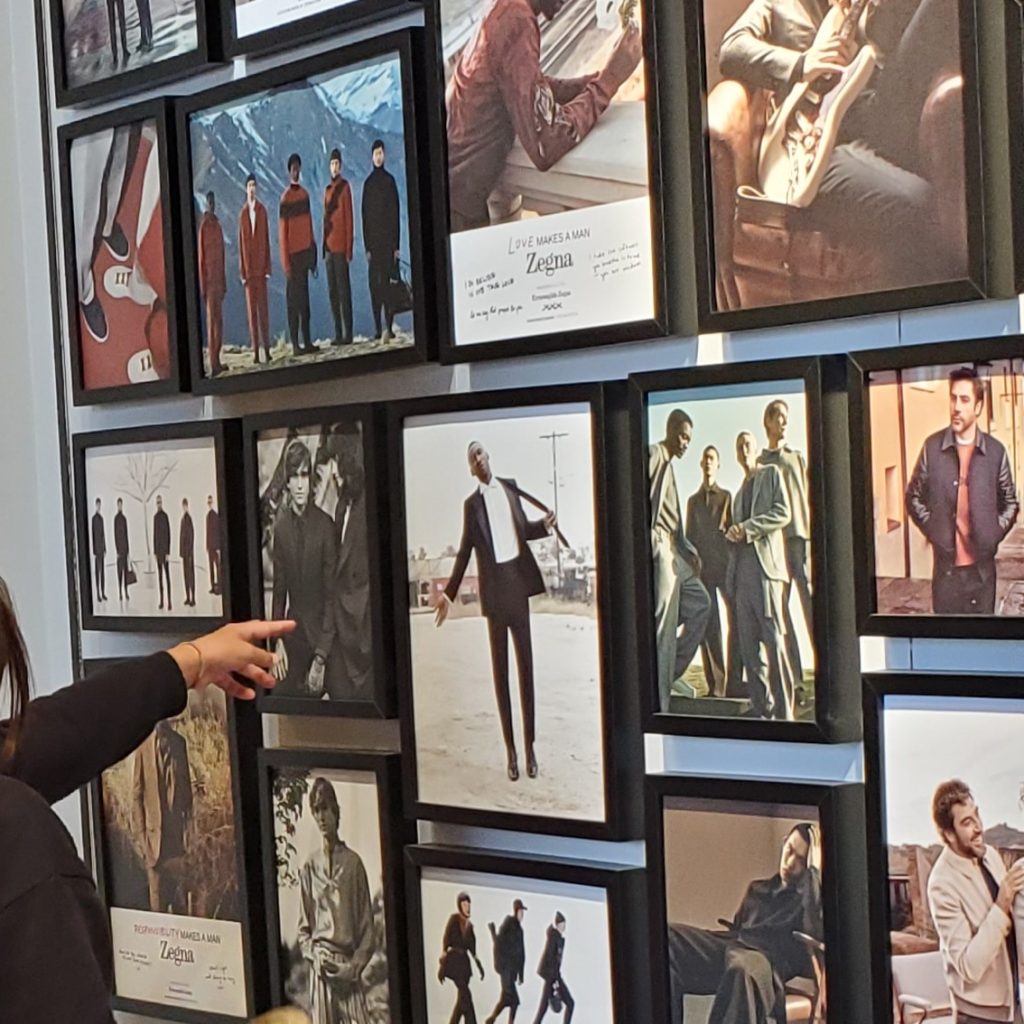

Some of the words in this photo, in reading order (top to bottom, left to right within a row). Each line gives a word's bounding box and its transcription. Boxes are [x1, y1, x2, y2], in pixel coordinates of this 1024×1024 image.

[508, 236, 534, 255] LOVE
[536, 232, 564, 246] MAKES
[571, 227, 591, 239] MAN
[526, 252, 574, 277] Zegna
[180, 929, 201, 942] MAKES
[206, 933, 222, 944] MAN
[160, 940, 195, 967] Zegna
